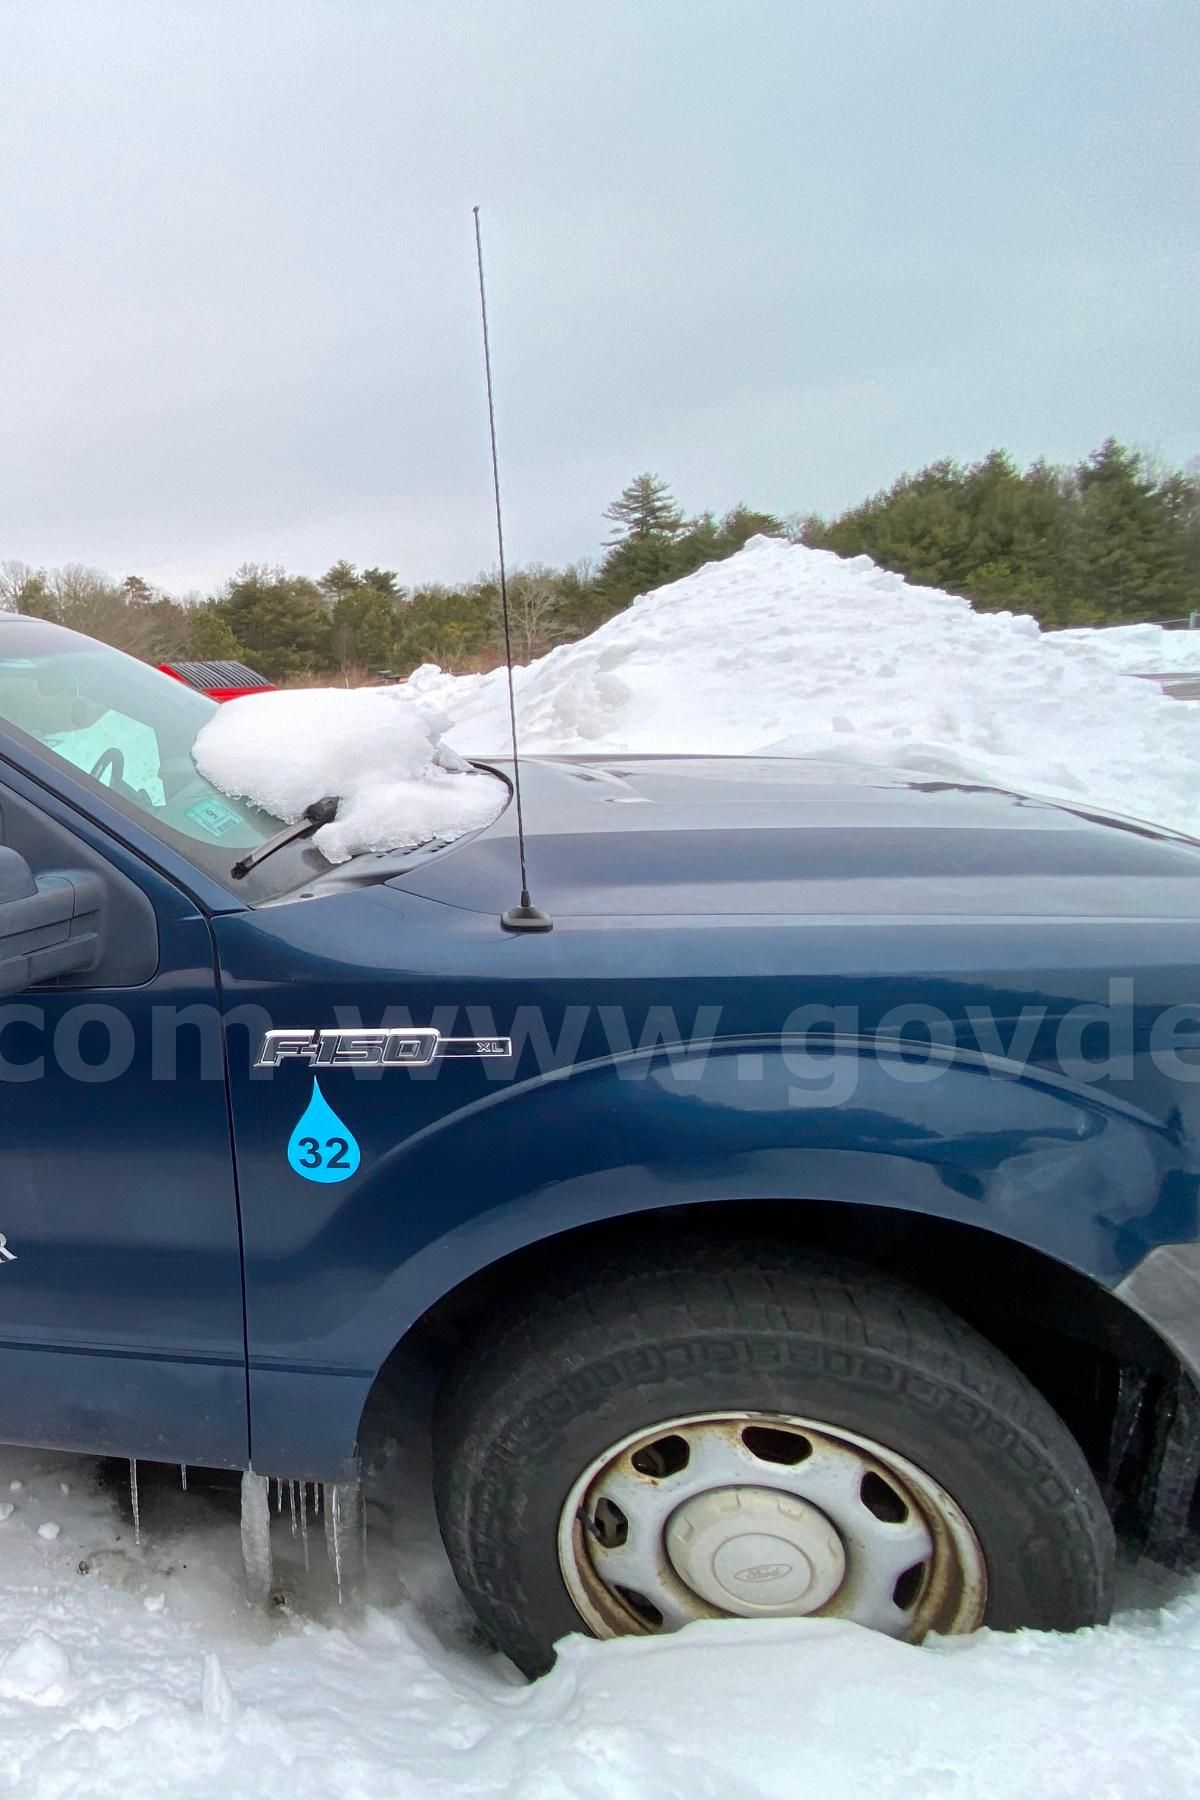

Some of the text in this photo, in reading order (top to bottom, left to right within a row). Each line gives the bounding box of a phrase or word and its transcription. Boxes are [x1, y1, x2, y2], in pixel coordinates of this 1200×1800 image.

[254, 1028, 504, 1067] F-150 XL
[298, 1137, 350, 1168] 32
